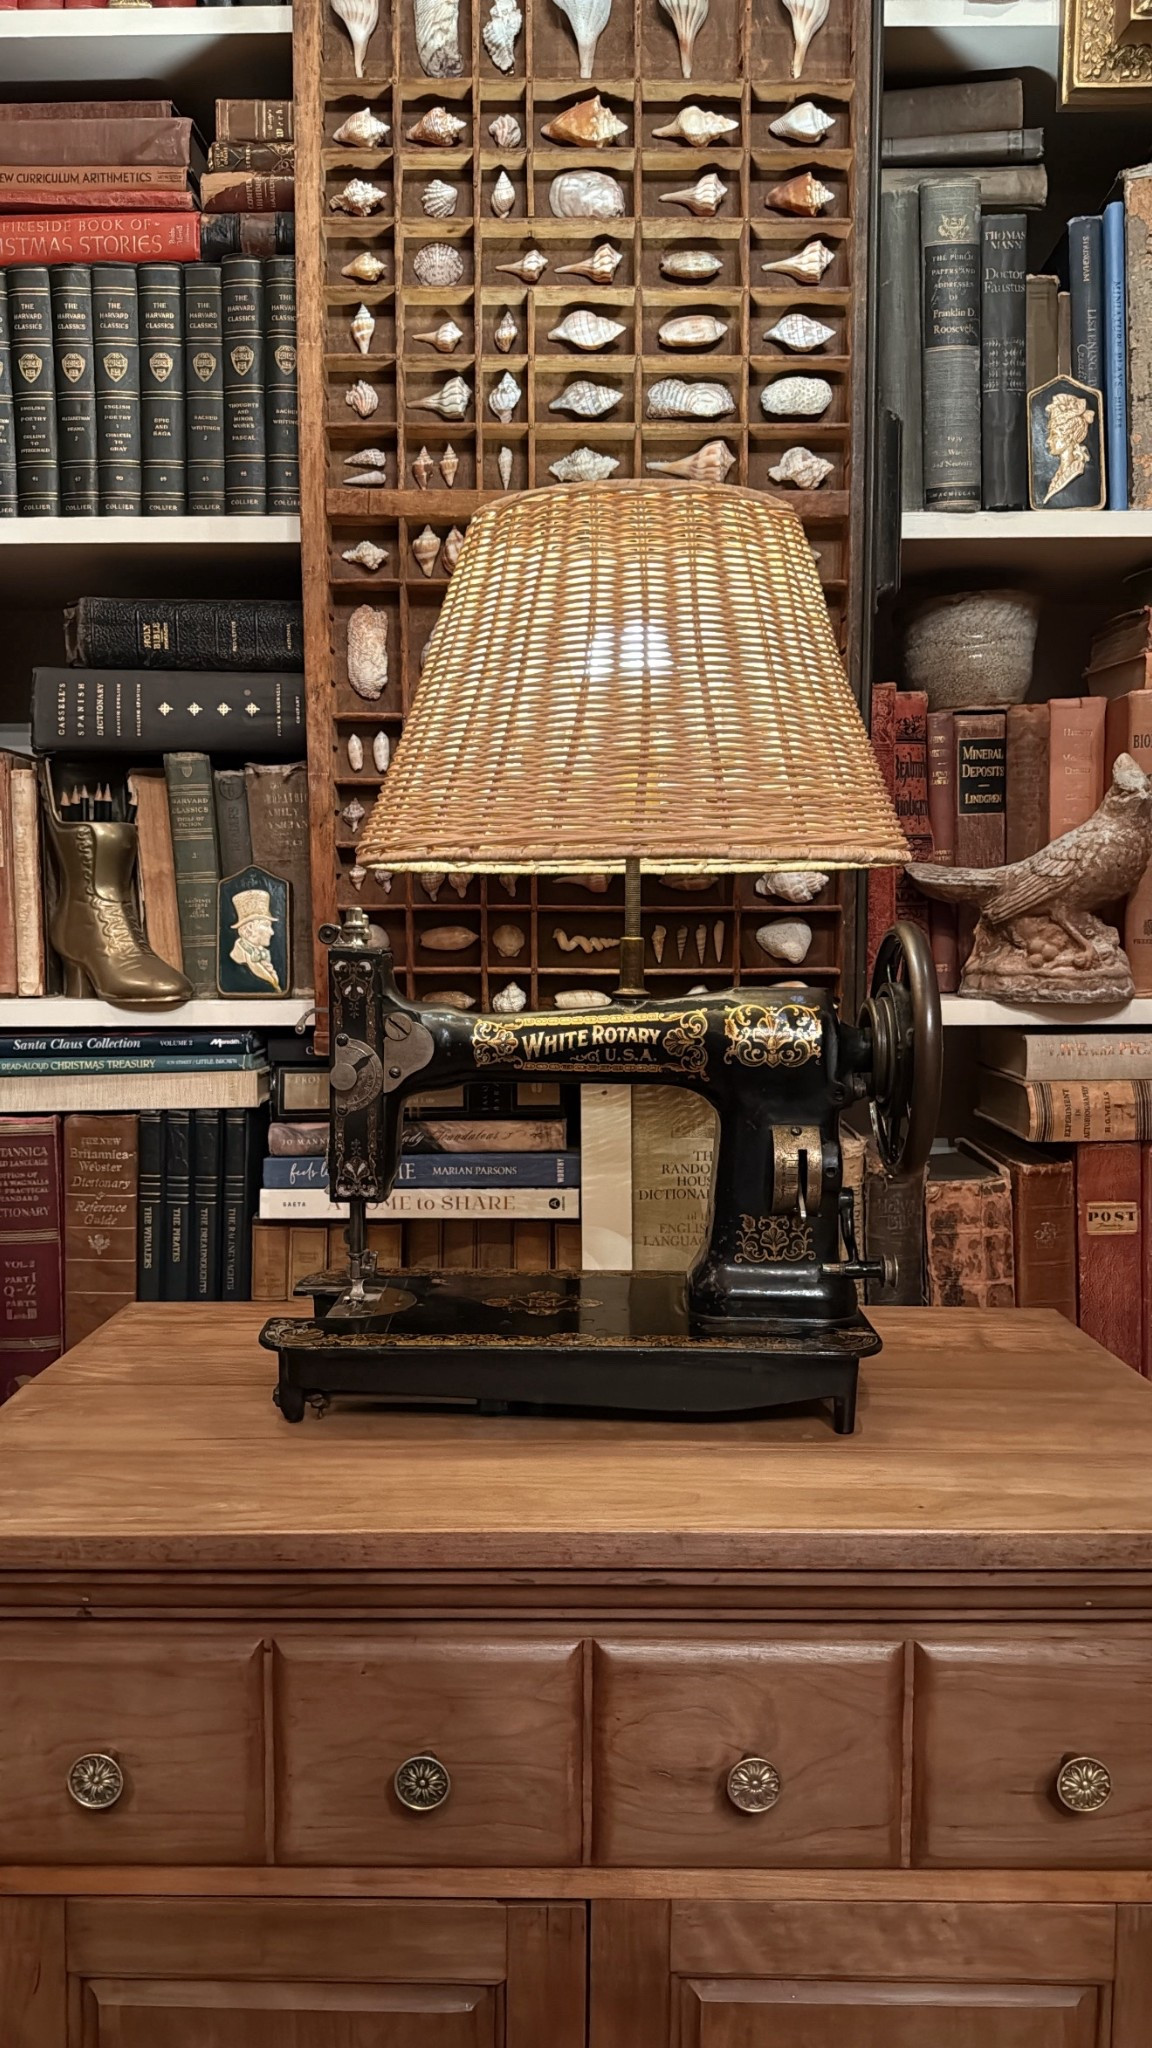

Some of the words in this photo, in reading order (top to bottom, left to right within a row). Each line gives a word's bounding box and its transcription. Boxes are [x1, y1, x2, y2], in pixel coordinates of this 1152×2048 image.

[0, 173, 13, 182] EW
[16, 173, 79, 184] CURRICULUM
[83, 172, 152, 183] ARITHMETICS
[3, 221, 71, 233] FIRESIDE
[79, 219, 124, 232] BOOK
[131, 219, 152, 231] OF
[984, 231, 1026, 240] THOMAS
[0, 237, 72, 256] ISTMAS
[79, 235, 162, 254] STORIES
[991, 241, 1022, 249] MANN
[1082, 236, 1090, 282] STRINGHAM
[985, 267, 1025, 280] Doctor
[984, 281, 1025, 293] Faustus
[108, 302, 121, 310] THE
[933, 308, 965, 319] Franklin
[1113, 281, 1121, 347] MINIATURE
[1087, 309, 1097, 370] LISTENING
[143, 623, 152, 648] HOLY
[152, 622, 161, 650] BIBLE
[57, 683, 66, 736] CASSELL'S
[77, 683, 85, 736] SPANISH
[96, 682, 104, 736] DICTIONARY
[1133, 734, 1152, 749] BIO
[962, 745, 1004, 760] MINERAL
[961, 763, 1005, 778] DEPOSITS
[964, 793, 1002, 804] LINDGREN
[13, 1039, 46, 1050] Santa
[50, 1039, 83, 1050] Claus
[87, 1037, 141, 1049] Collection
[521, 1029, 588, 1060] WHITE
[592, 1025, 661, 1046] ROTARY
[605, 1048, 657, 1062] U.S.A.
[1, 1062, 49, 1070] READ-ALOUD
[50, 1060, 104, 1070] CHRISTMAS
[107, 1059, 156, 1069] TREASURY
[1062, 1088, 1071, 1138] EXPERIMENT
[1081, 1085, 1091, 1139] AUTOBIOGRAPHY
[99, 1137, 122, 1145] NEW
[0, 1146, 48, 1157] TANNICA
[693, 1150, 712, 1161] TH
[79, 1161, 122, 1172] Webster
[289, 1161, 318, 1185] feels
[433, 1167, 474, 1175] MARIAN
[475, 1167, 517, 1175] PARSONS
[557, 1158, 565, 1183] WORTHY
[662, 1163, 710, 1175] RANDO
[71, 1176, 131, 1189] Dictionary
[677, 1176, 710, 1187] HOUS
[75, 1200, 128, 1212] Reference
[365, 1196, 412, 1211] OME
[417, 1197, 435, 1211] to
[441, 1196, 516, 1211] SHARE
[84, 1213, 118, 1225] Guide
[144, 1207, 152, 1224] THE
[200, 1208, 208, 1225] THE
[228, 1208, 236, 1224] THE
[1088, 1211, 1136, 1222] POST
[658, 1222, 706, 1233] ENGLIS
[144, 1226, 152, 1268] WHALERS
[172, 1228, 180, 1262] PIRATES
[199, 1227, 208, 1293] DREADNOUGHTS
[227, 1258, 235, 1290] YACHTS
